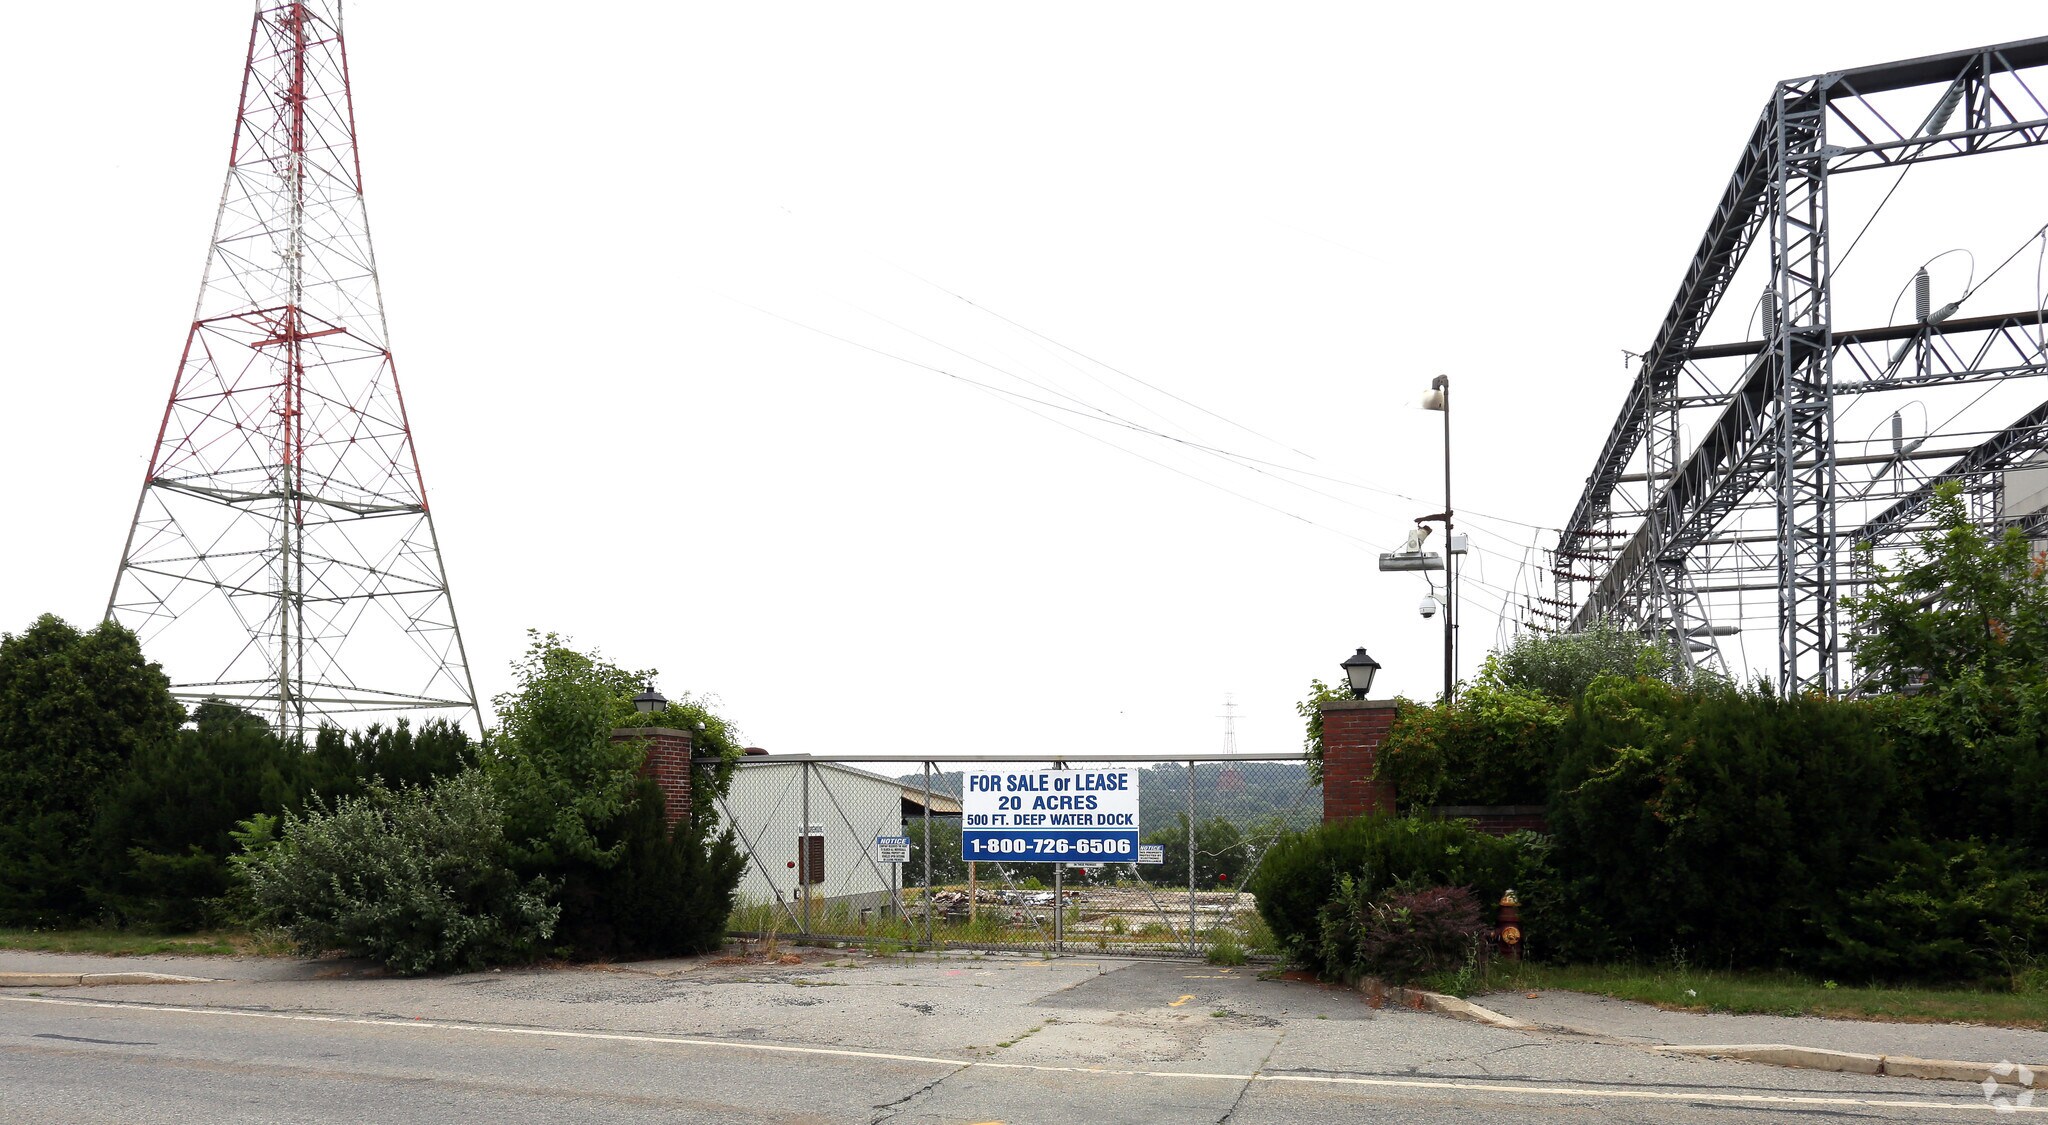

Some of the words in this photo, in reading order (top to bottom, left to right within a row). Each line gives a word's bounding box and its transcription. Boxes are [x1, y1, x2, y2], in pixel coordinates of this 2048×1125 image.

[970, 775, 1001, 792] FOR
[1007, 774, 1049, 792] SALE
[1054, 777, 1071, 791] or
[1075, 773, 1128, 791] LEASE
[998, 796, 1022, 810] 20
[1032, 795, 1098, 810] ACRES
[967, 814, 988, 825] 500
[992, 814, 1009, 825] FT.
[1013, 814, 1046, 825] DEEP
[1050, 814, 1093, 825] WATER
[1097, 813, 1133, 825] DOCK
[970, 838, 1131, 854] 1-800-726-6506
